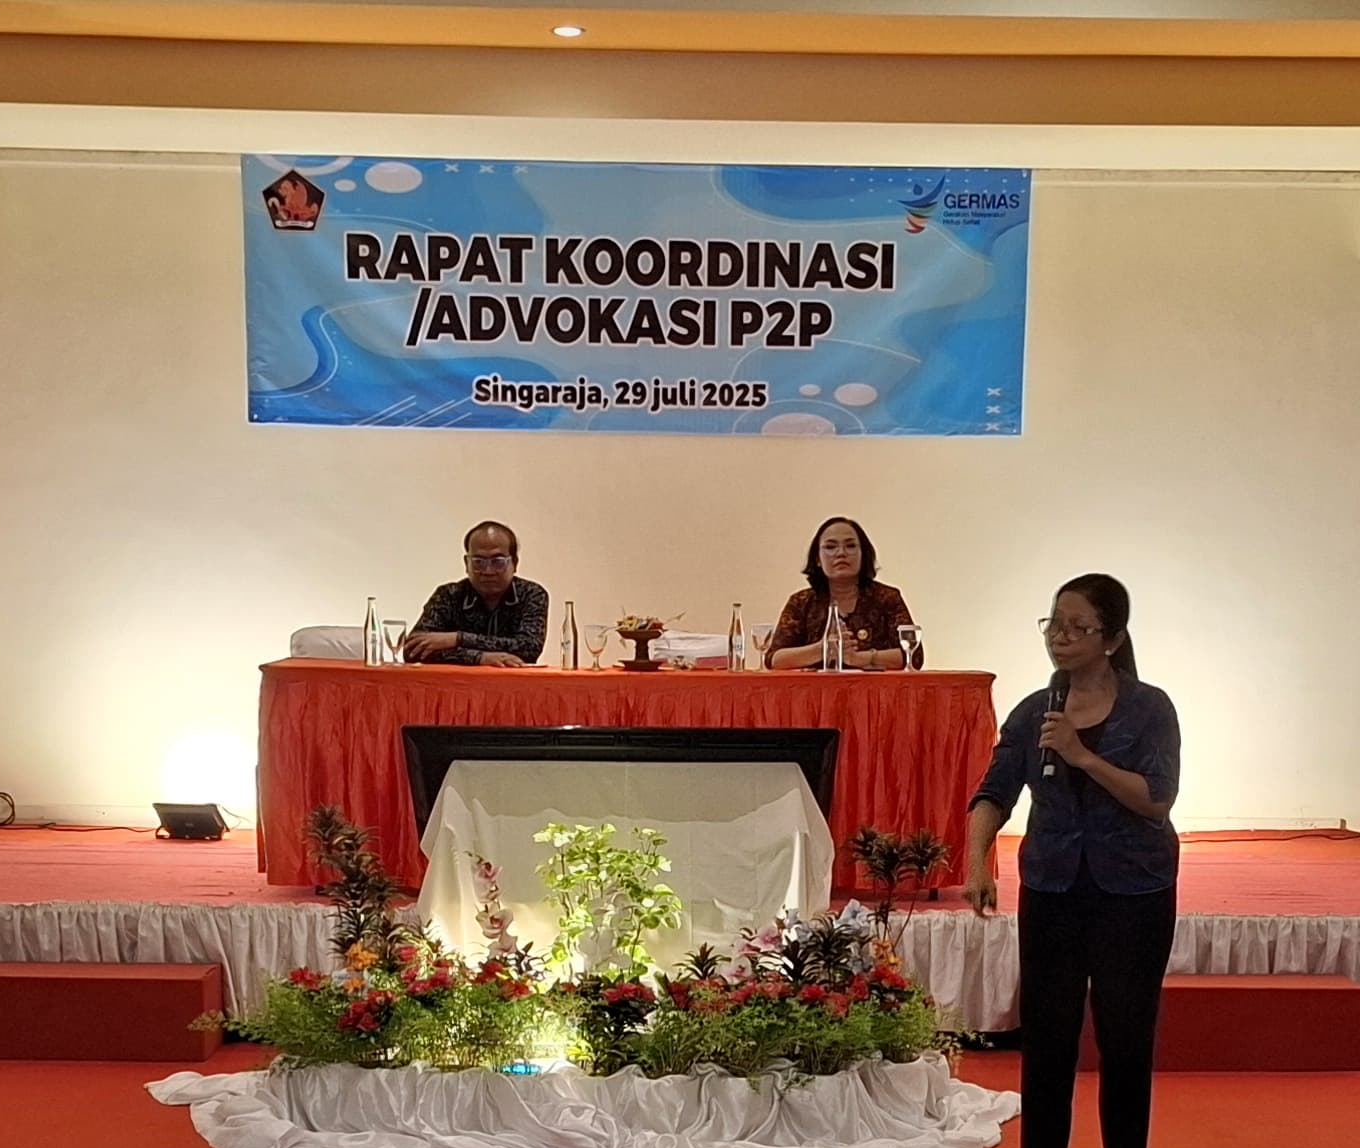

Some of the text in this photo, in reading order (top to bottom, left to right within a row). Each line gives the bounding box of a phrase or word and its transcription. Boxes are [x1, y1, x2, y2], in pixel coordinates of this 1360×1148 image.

[943, 193, 1020, 209] GERMAS
[347, 233, 894, 290] RAPAT KOORDINASI
[406, 288, 832, 347] /ADVOKASI P2P
[473, 375, 767, 412] Singaraja, 29 juli 2025
